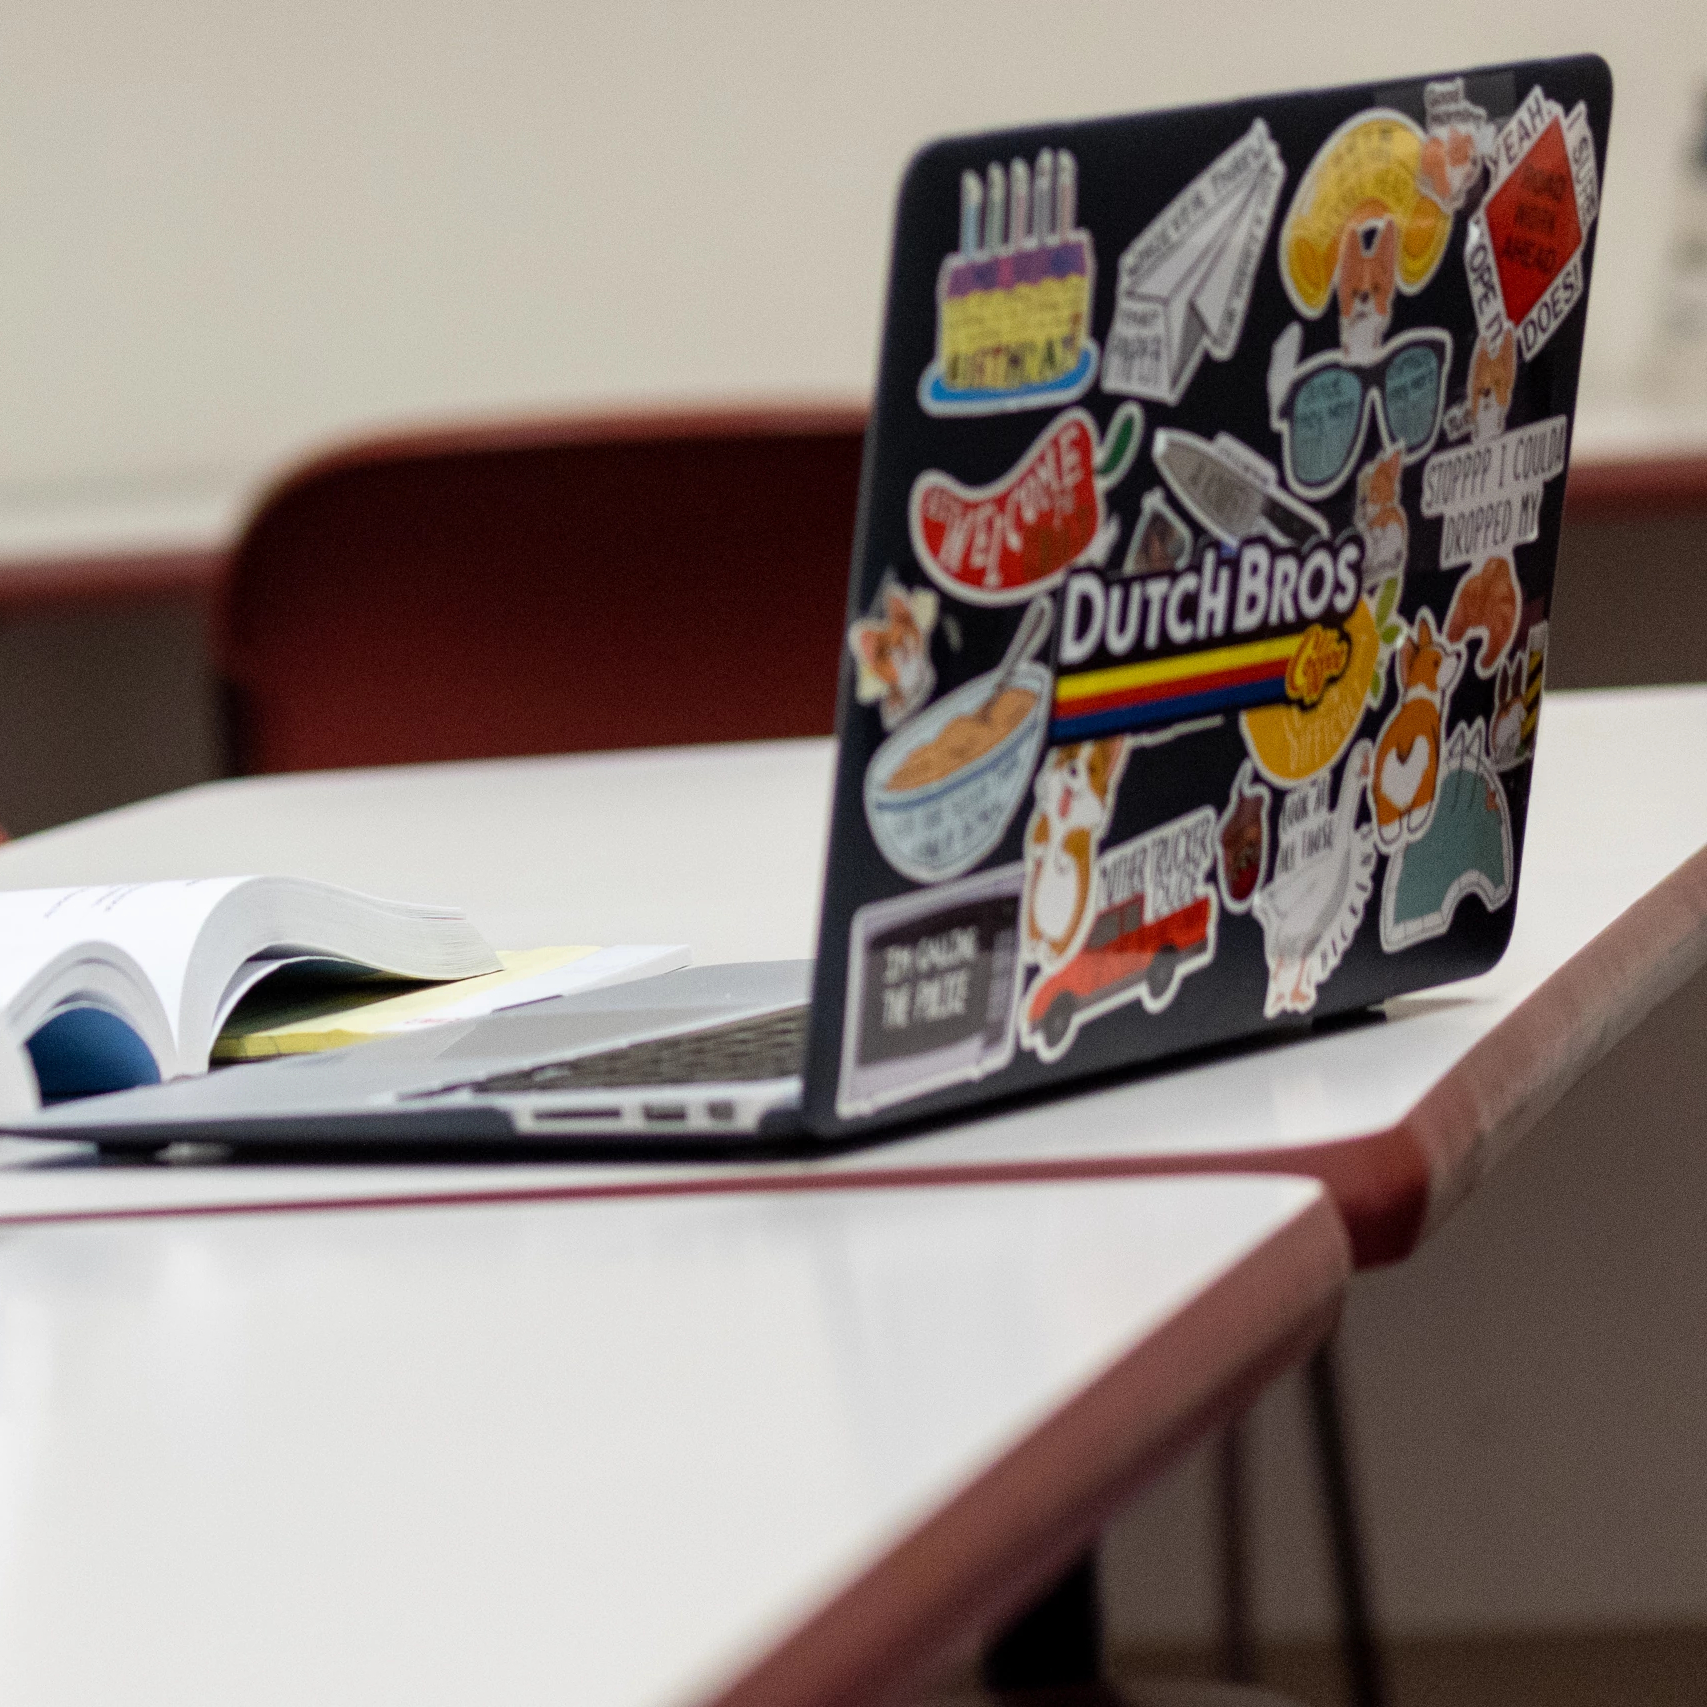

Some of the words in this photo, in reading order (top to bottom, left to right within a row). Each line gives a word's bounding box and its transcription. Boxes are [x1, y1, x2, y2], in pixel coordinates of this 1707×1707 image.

[1522, 268, 1581, 353] DOES!
[1497, 443, 1507, 489] I
[937, 424, 1082, 588] WELCOME
[1444, 498, 1513, 560] DROPPED
[1517, 492, 1539, 537] MY
